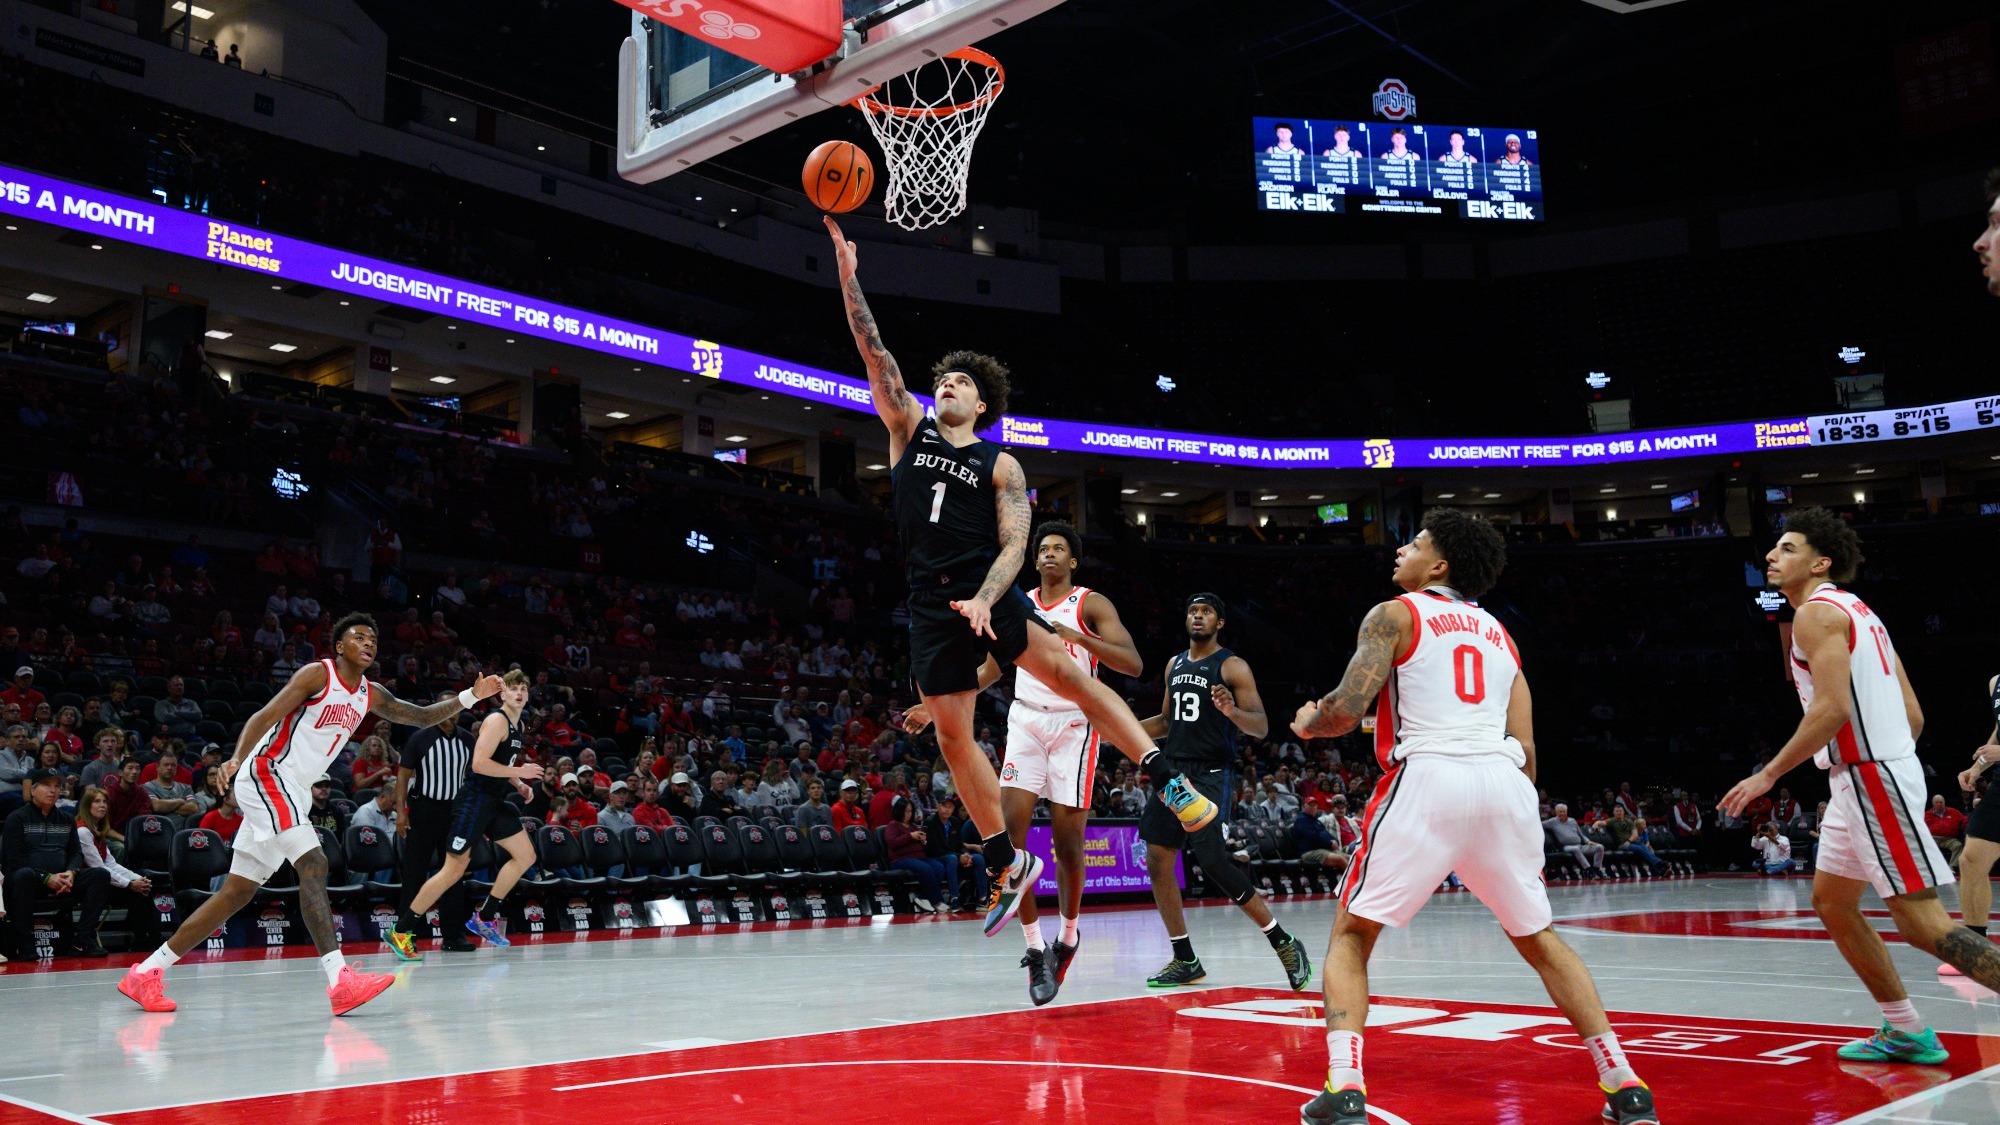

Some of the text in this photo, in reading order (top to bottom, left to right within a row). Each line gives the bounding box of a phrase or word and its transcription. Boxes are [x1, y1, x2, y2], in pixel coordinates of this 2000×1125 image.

[1467, 128, 1480, 137] 33
[1527, 130, 1537, 139] 13
[36, 190, 57, 212] A
[63, 196, 155, 235] MONTH
[208, 221, 273, 253] Planet
[207, 240, 281, 272] Fitness
[331, 262, 452, 305] JUDGEMENT
[514, 305, 549, 329] FOR
[553, 314, 580, 337] $15
[583, 322, 597, 339] A
[600, 326, 658, 354] MONTH
[754, 364, 836, 397] JUDGEMENT
[1002, 414, 1044, 433] Planet
[1825, 415, 1866, 426] FG/ATT
[1895, 407, 1945, 420] 3PT/ATT
[1754, 420, 1807, 437] Planet
[1818, 424, 1879, 442] 18-33
[1893, 416, 1950, 436] 8-15
[1002, 429, 1050, 447] Fitness
[1081, 431, 1165, 451] JUDGEMENT
[1209, 443, 1236, 457] FOR
[1238, 445, 1258, 460] $15
[1261, 448, 1271, 460] A
[1274, 447, 1329, 461] MONTH
[1428, 446, 1520, 460] JUDGEMENT
[1572, 443, 1605, 458] FOR
[1608, 440, 1634, 455] $15
[1638, 439, 1652, 452] A
[1654, 433, 1717, 452] MONTH
[913, 453, 979, 488] BUTLER
[929, 481, 947, 523] 1
[1426, 613, 1504, 650] MOBLEY JR.
[1171, 674, 1208, 689] BUTLER
[1453, 643, 1485, 705] 0
[314, 704, 346, 730] OHIO
[1173, 692, 1200, 722] 13
[326, 733, 342, 757] 1
[1039, 878, 1059, 889] Prou
[1095, 876, 1104, 887] of
[1105, 876, 1121, 886] Ohio
[1122, 875, 1141, 886] State
[161, 913, 171, 922] A1
[207, 939, 224, 949] AA1
[267, 934, 284, 945] AA2
